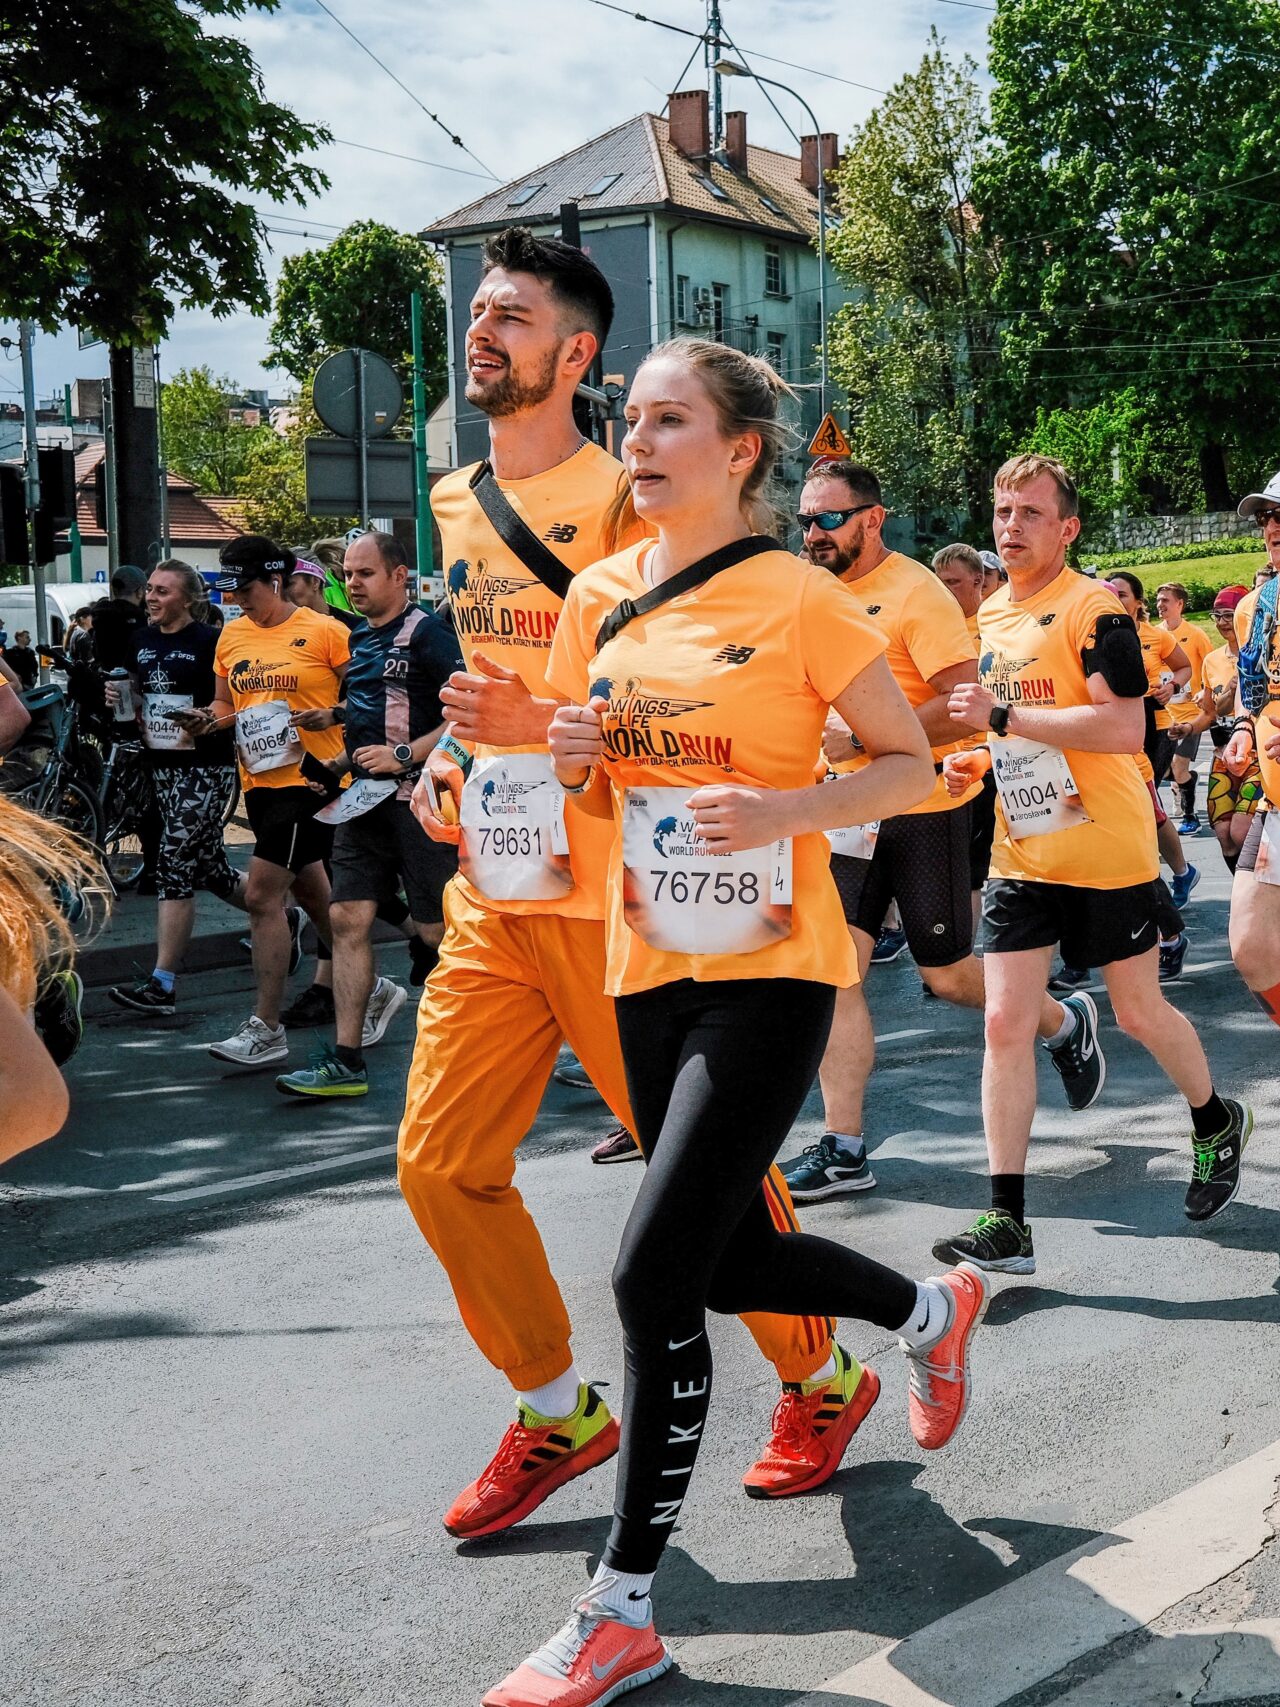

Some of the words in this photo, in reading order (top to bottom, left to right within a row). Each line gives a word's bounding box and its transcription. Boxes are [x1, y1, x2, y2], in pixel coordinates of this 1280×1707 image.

[467, 578, 508, 593] WINGS
[474, 593, 496, 606] LIFE
[456, 606, 514, 636] WORLD
[178, 652, 196, 661] DFDS
[992, 662, 1017, 672] WINGS
[238, 676, 274, 692] WORLD
[274, 675, 298, 689] RUN
[994, 672, 1010, 682] LIFE
[1021, 678, 1055, 699] RUN
[608, 698, 670, 715] WINGS
[618, 714, 652, 728] LIFE
[290, 730, 298, 740] 3
[678, 732, 732, 766] RUN
[1002, 756, 1028, 768] WINGS
[1008, 766, 1022, 774] LIFE
[496, 782, 524, 794] WINGS
[1064, 778, 1074, 791] 4
[501, 794, 516, 804] LIFE
[1002, 782, 1058, 810] 11004
[478, 827, 542, 856] 79631
[668, 846, 694, 856] WORLD
[650, 870, 760, 904] 76758
[650, 1375, 708, 1525] NIKE
